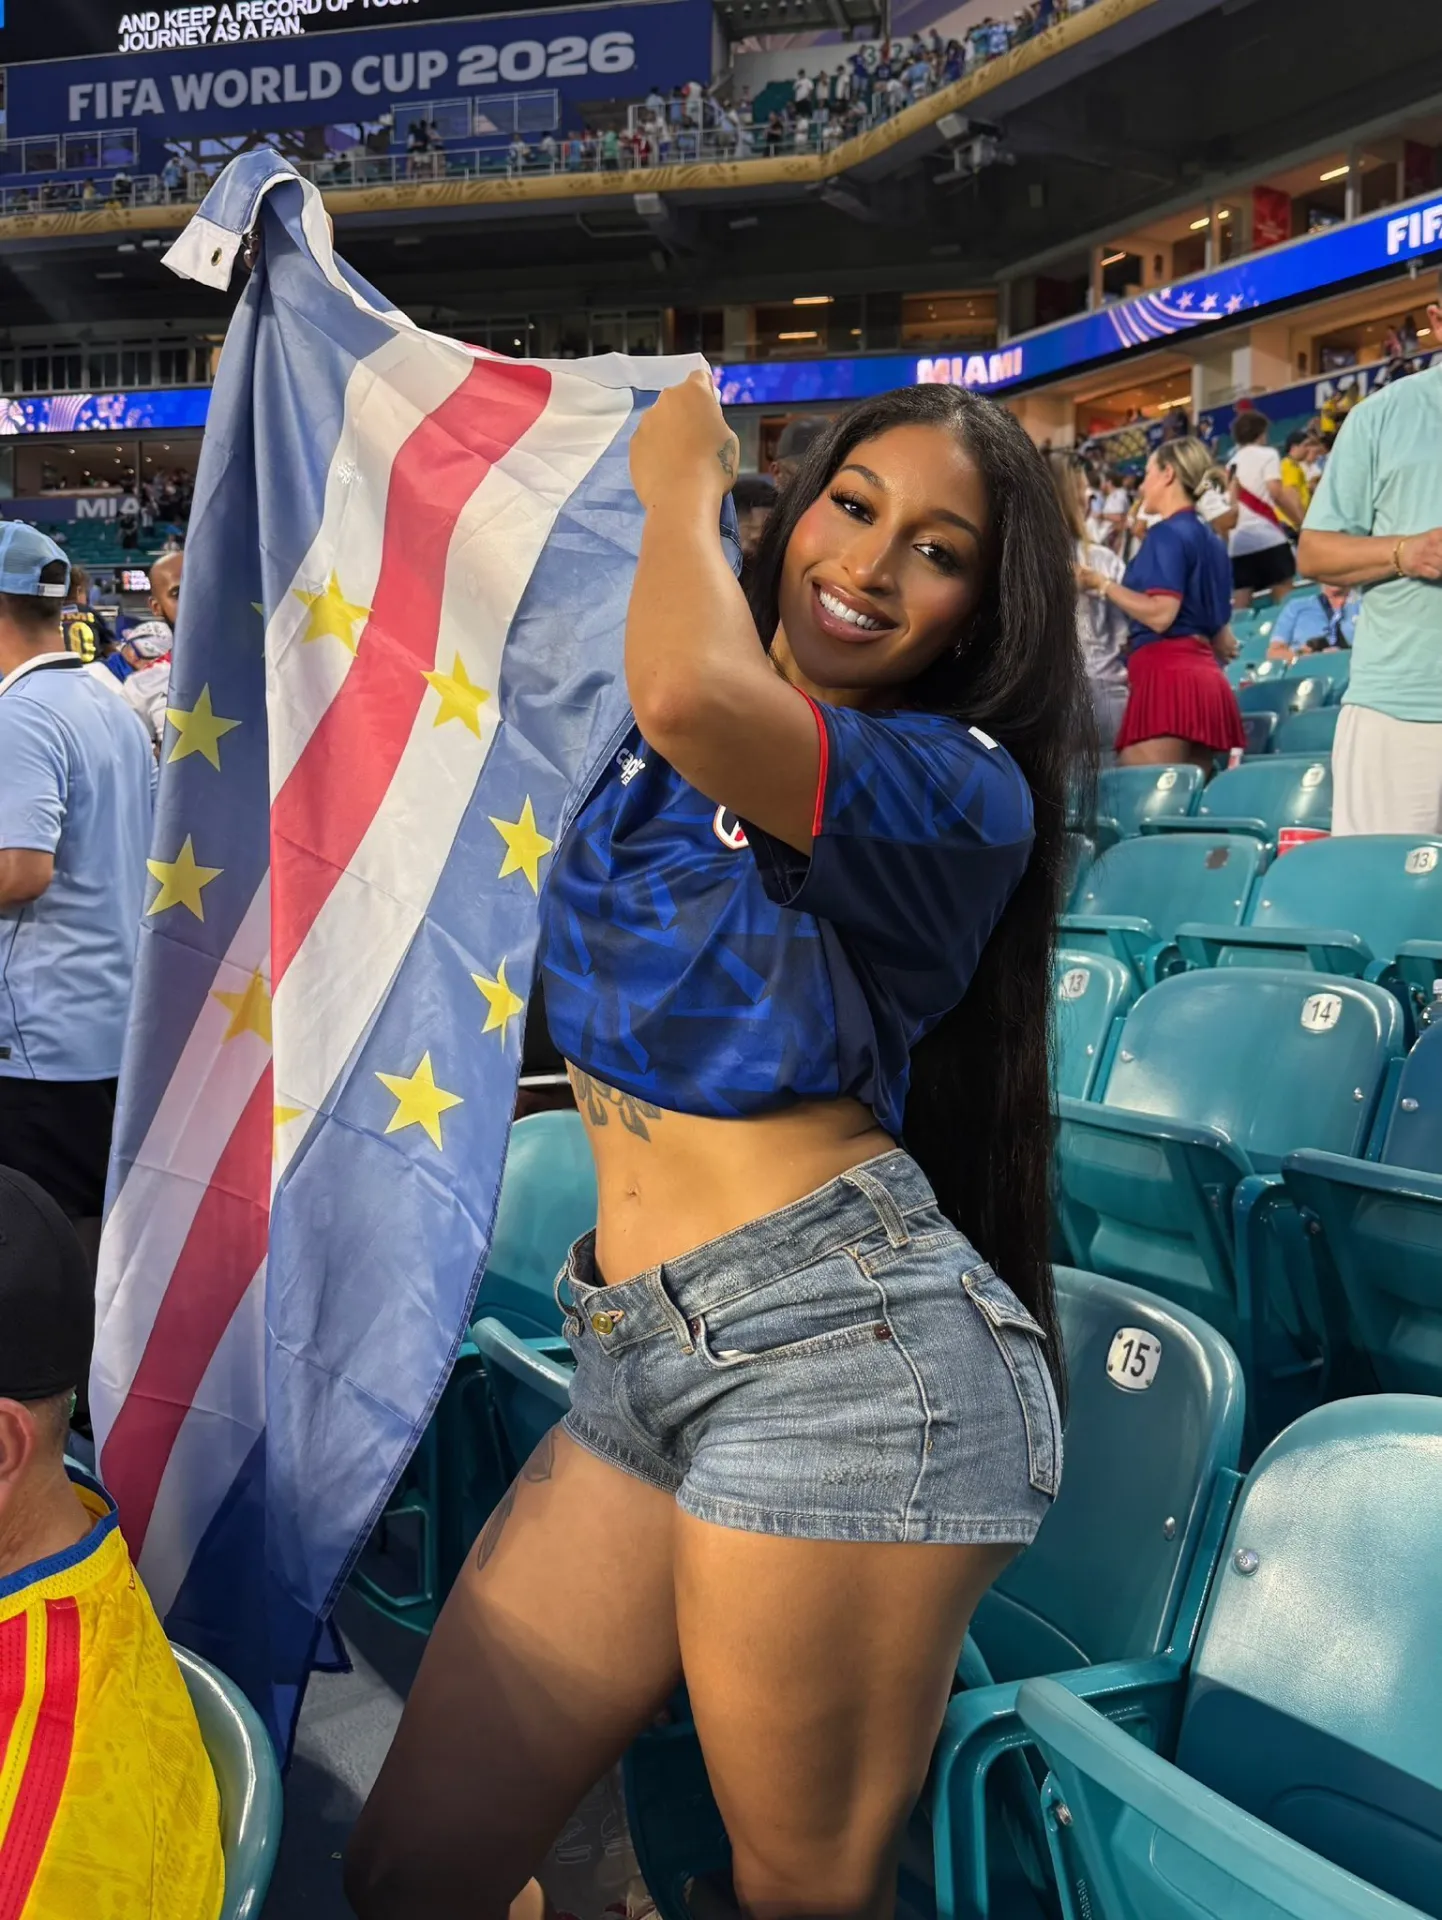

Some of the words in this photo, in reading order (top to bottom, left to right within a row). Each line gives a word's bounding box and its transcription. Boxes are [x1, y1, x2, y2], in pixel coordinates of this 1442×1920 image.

[118, 12, 160, 34] AND
[164, 6, 216, 28] KEEP
[218, 4, 233, 24] A
[236, 0, 322, 21] RECORD
[118, 24, 211, 52] JOURNEY
[213, 22, 240, 42] AS
[243, 21, 259, 40] A
[261, 15, 305, 38] FAN.
[69, 78, 165, 121] FIFA
[171, 60, 342, 112] WORLD
[351, 49, 448, 95] CUP
[457, 31, 635, 86] 2026
[1387, 204, 1442, 255] FIF
[917, 347, 1022, 385] MIAMI
[1413, 852, 1429, 868] 13
[1312, 1001, 1332, 1022] 14
[1121, 1339, 1150, 1377] 15
